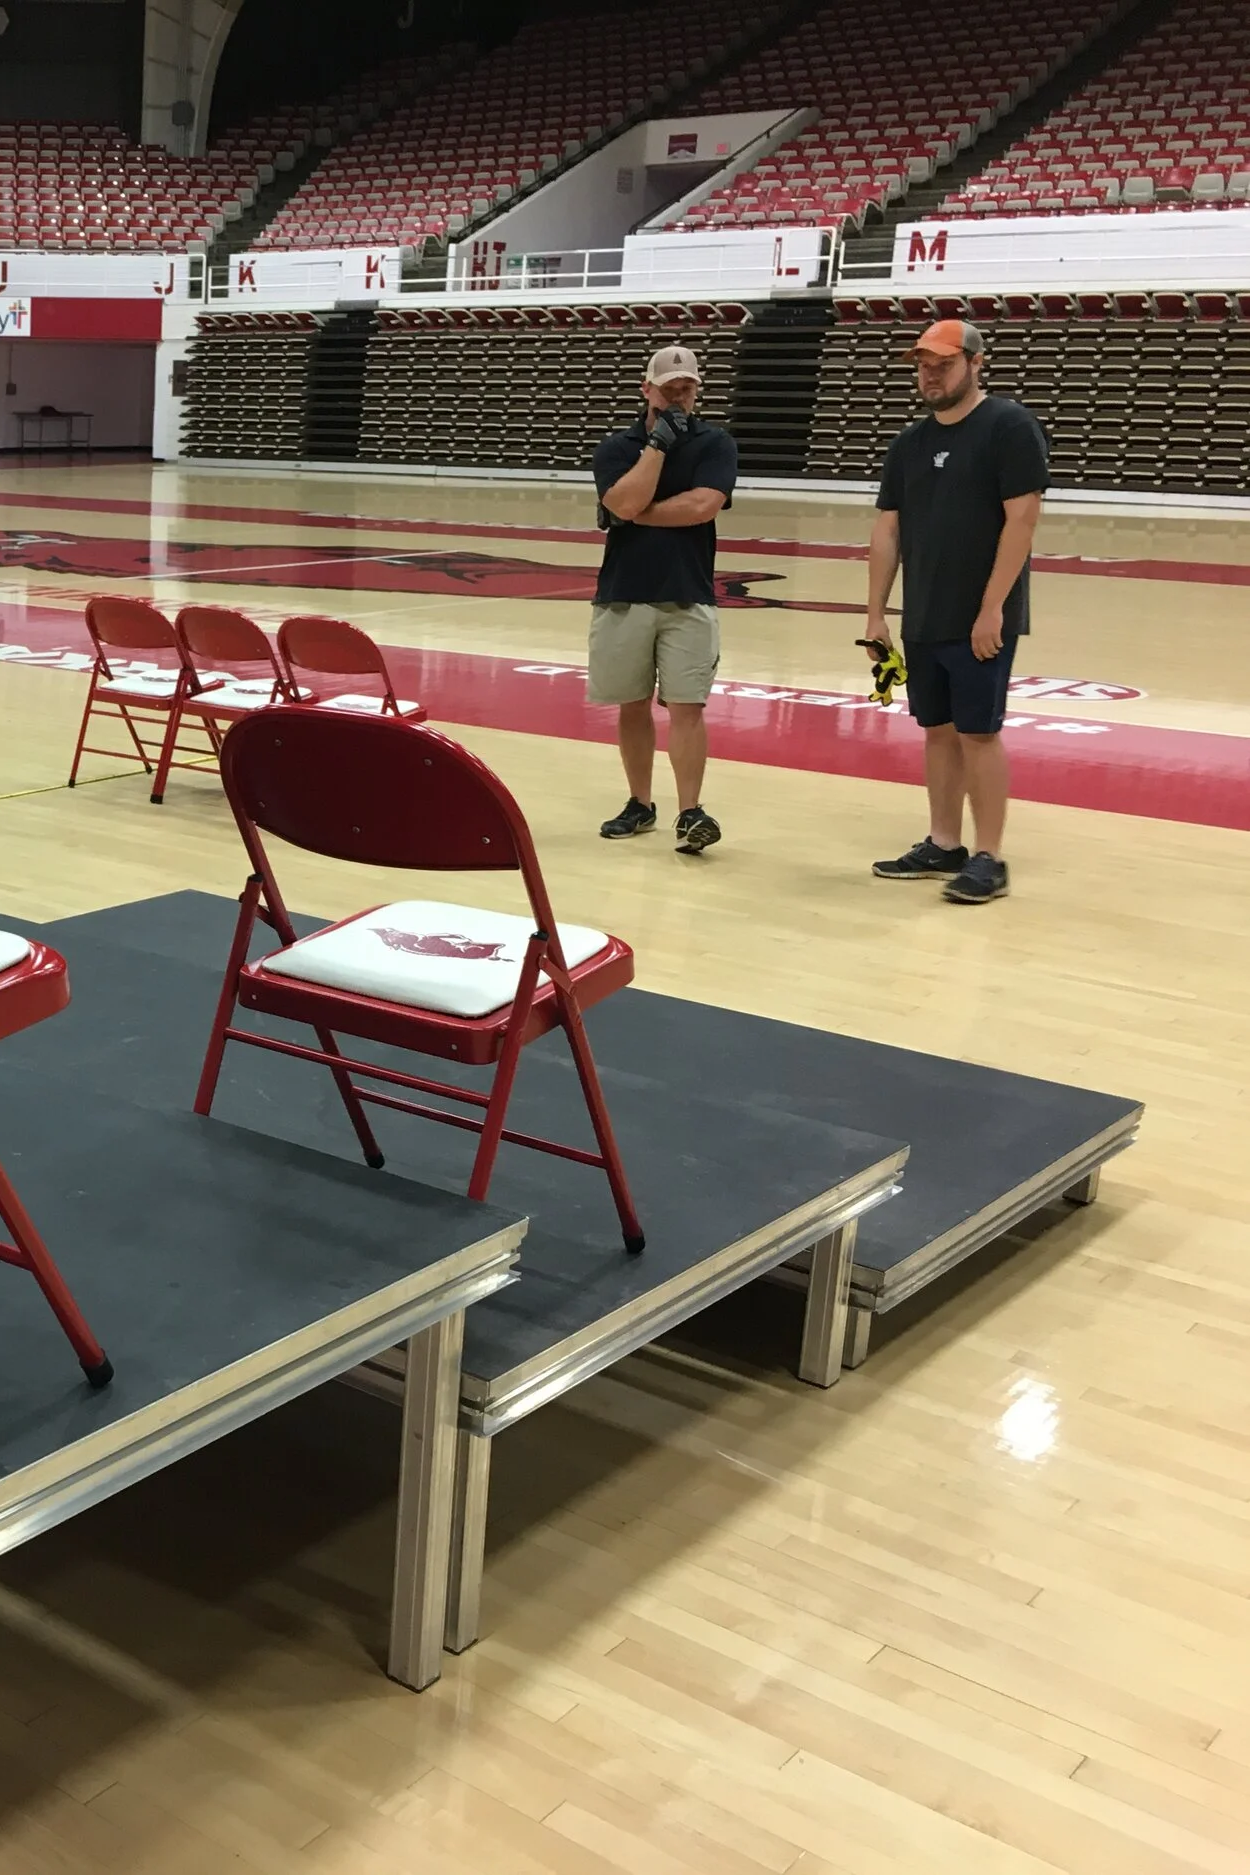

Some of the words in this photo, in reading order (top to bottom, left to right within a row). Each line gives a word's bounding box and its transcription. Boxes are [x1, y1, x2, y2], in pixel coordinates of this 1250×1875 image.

[773, 236, 800, 277] L
[907, 230, 948, 272] M
[153, 262, 174, 295] J
[238, 260, 258, 293] K
[364, 254, 387, 290] K
[1008, 676, 1130, 701] SE
